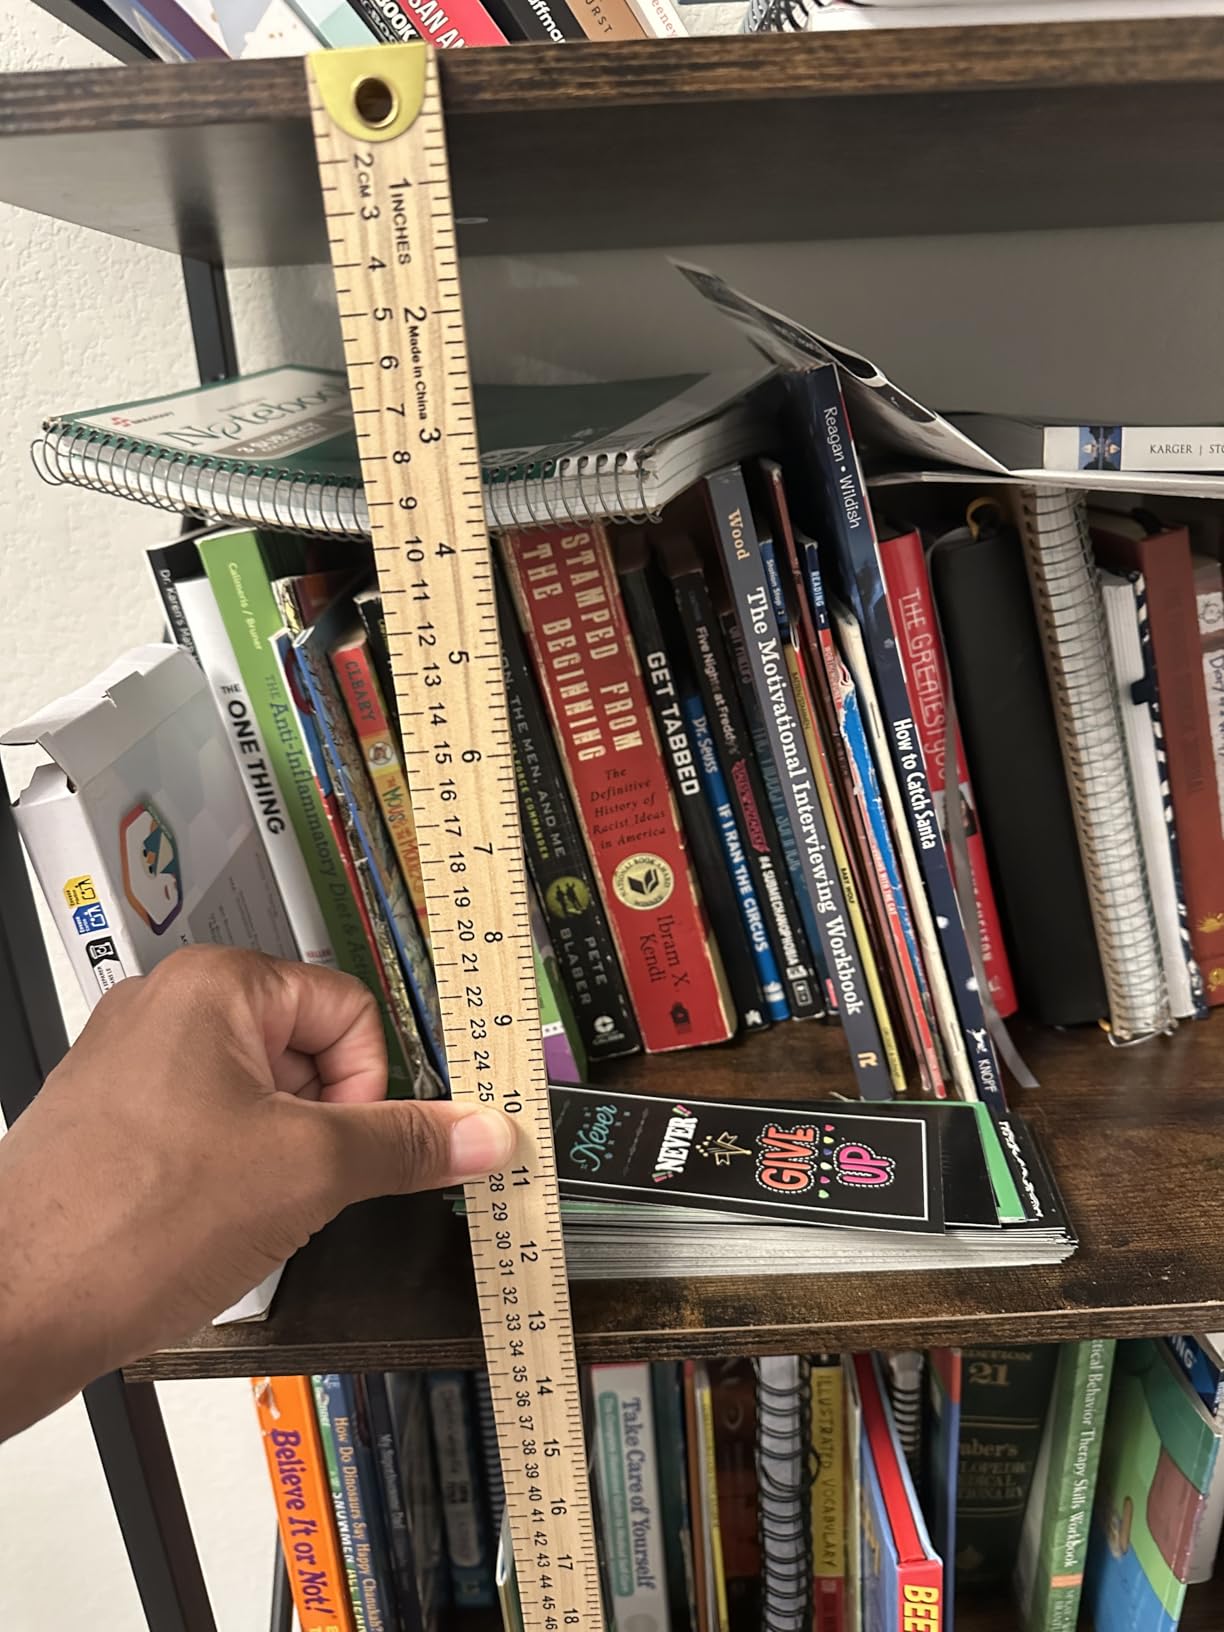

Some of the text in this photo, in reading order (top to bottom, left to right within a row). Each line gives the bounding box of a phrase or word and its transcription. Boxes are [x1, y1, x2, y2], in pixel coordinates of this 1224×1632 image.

[354, 153, 374, 198] 2 CM
[361, 206, 380, 221] 3
[389, 178, 412, 265] 1 INCHES
[368, 256, 386, 272] 4
[373, 307, 393, 321] 5
[404, 306, 427, 323] 2
[379, 355, 399, 369] 6
[408, 325, 428, 420] Made in China
[386, 403, 405, 417] 7
[419, 428, 441, 444] 3
[392, 451, 411, 464] 8
[1150, 444, 1193, 454] KARGER
[824, 406, 860, 529] Reagan Wildish
[399, 496, 417, 510] 9
[728, 506, 751, 560] Wood
[404, 536, 425, 562] 10
[435, 542, 456, 558] 4
[159, 569, 185, 627] Dr. Karen's
[411, 579, 431, 601] 11
[810, 570, 826, 624] READING 1
[417, 621, 436, 647] 12
[561, 532, 643, 751] STAMPED FROM
[448, 651, 470, 664] 5
[522, 542, 607, 762] THE BEGINNING
[902, 587, 946, 738] THE GREATEST
[423, 663, 442, 687] 13
[220, 683, 241, 694] THE
[696, 625, 740, 756] Five Nights at Freddy's
[647, 651, 701, 796] GET TABBED
[434, 741, 452, 764] 15
[461, 750, 482, 763] 6
[692, 717, 718, 774] Dr. Seuss
[228, 700, 286, 835] ONE THING
[265, 675, 338, 878] THE Anti-Inflammatory
[511, 696, 528, 733] THE
[522, 738, 541, 783] MEN,
[537, 790, 556, 827] AND
[551, 833, 566, 857] ME
[606, 768, 627, 781] The
[590, 779, 651, 803] Definitive
[893, 717, 936, 850] How to Catch Santa
[594, 792, 656, 818] History of
[717, 803, 733, 819] IF
[747, 586, 769, 634] The
[758, 637, 802, 779] Motivational
[791, 781, 837, 914] Interviewing
[825, 915, 864, 1016] Workbook
[444, 816, 462, 837] 17
[523, 797, 550, 860] COMMANDER
[592, 809, 665, 835] Racist Ideas
[473, 842, 493, 855] 7
[600, 827, 666, 849] in America
[724, 830, 744, 865] RAN
[758, 855, 772, 869] #4
[733, 863, 752, 895] THE
[453, 886, 471, 907] 19
[743, 896, 769, 953] CIRCUS
[762, 869, 800, 967] SUBMECHANOPHOBIA
[484, 931, 503, 943] 8
[657, 914, 681, 967] Ibram
[462, 953, 479, 973] 21
[559, 928, 592, 1005] BLABER
[584, 936, 608, 985] PETE
[640, 934, 667, 983] Kendi
[470, 1018, 487, 1040] 23
[494, 1015, 513, 1026] 9
[474, 1050, 490, 1071] 24
[977, 1058, 998, 1093] KNOPF
[477, 1081, 494, 1102] 25
[502, 1089, 522, 1113] 10
[570, 1104, 618, 1172] Never
[654, 1117, 698, 1173] NEVER
[760, 1126, 816, 1191] GIVE
[839, 1146, 891, 1185] UP
[489, 1173, 505, 1192] 28
[511, 1166, 530, 1186] 11
[495, 1231, 511, 1250] 30
[520, 1241, 538, 1263] 12
[502, 1286, 518, 1304] 32
[528, 1310, 546, 1331] 13
[509, 1339, 524, 1357] 34
[536, 1376, 553, 1396] 14
[969, 1362, 1009, 1387] 21
[516, 1390, 531, 1407] 36
[1081, 1374, 1104, 1426] Behavior
[333, 1416, 349, 1443] How
[339, 1446, 354, 1462] Do
[522, 1439, 537, 1455] 38
[543, 1438, 560, 1457] 15
[1073, 1428, 1096, 1479] Therapy
[271, 1429, 306, 1511] Believe
[342, 1465, 362, 1525] Dinosaurs
[528, 1486, 542, 1502] 40
[622, 1397, 655, 1590] Take Care of Yourself
[1071, 1478, 1089, 1510] Skills
[550, 1497, 567, 1516] 16
[288, 1515, 319, 1537] It
[352, 1521, 367, 1541] Say
[332, 1491, 354, 1564] SNOWMEN
[346, 1569, 359, 1593] ALL
[534, 1531, 548, 1546] 42
[1064, 1510, 1085, 1568] Workbook
[293, 1541, 316, 1565] or
[356, 1543, 371, 1577] Happy
[557, 1554, 573, 1571] 17
[298, 1568, 335, 1615] Not!
[539, 1574, 553, 1589] 44
[545, 1616, 558, 1630] 46
[563, 1608, 579, 1624] 18
